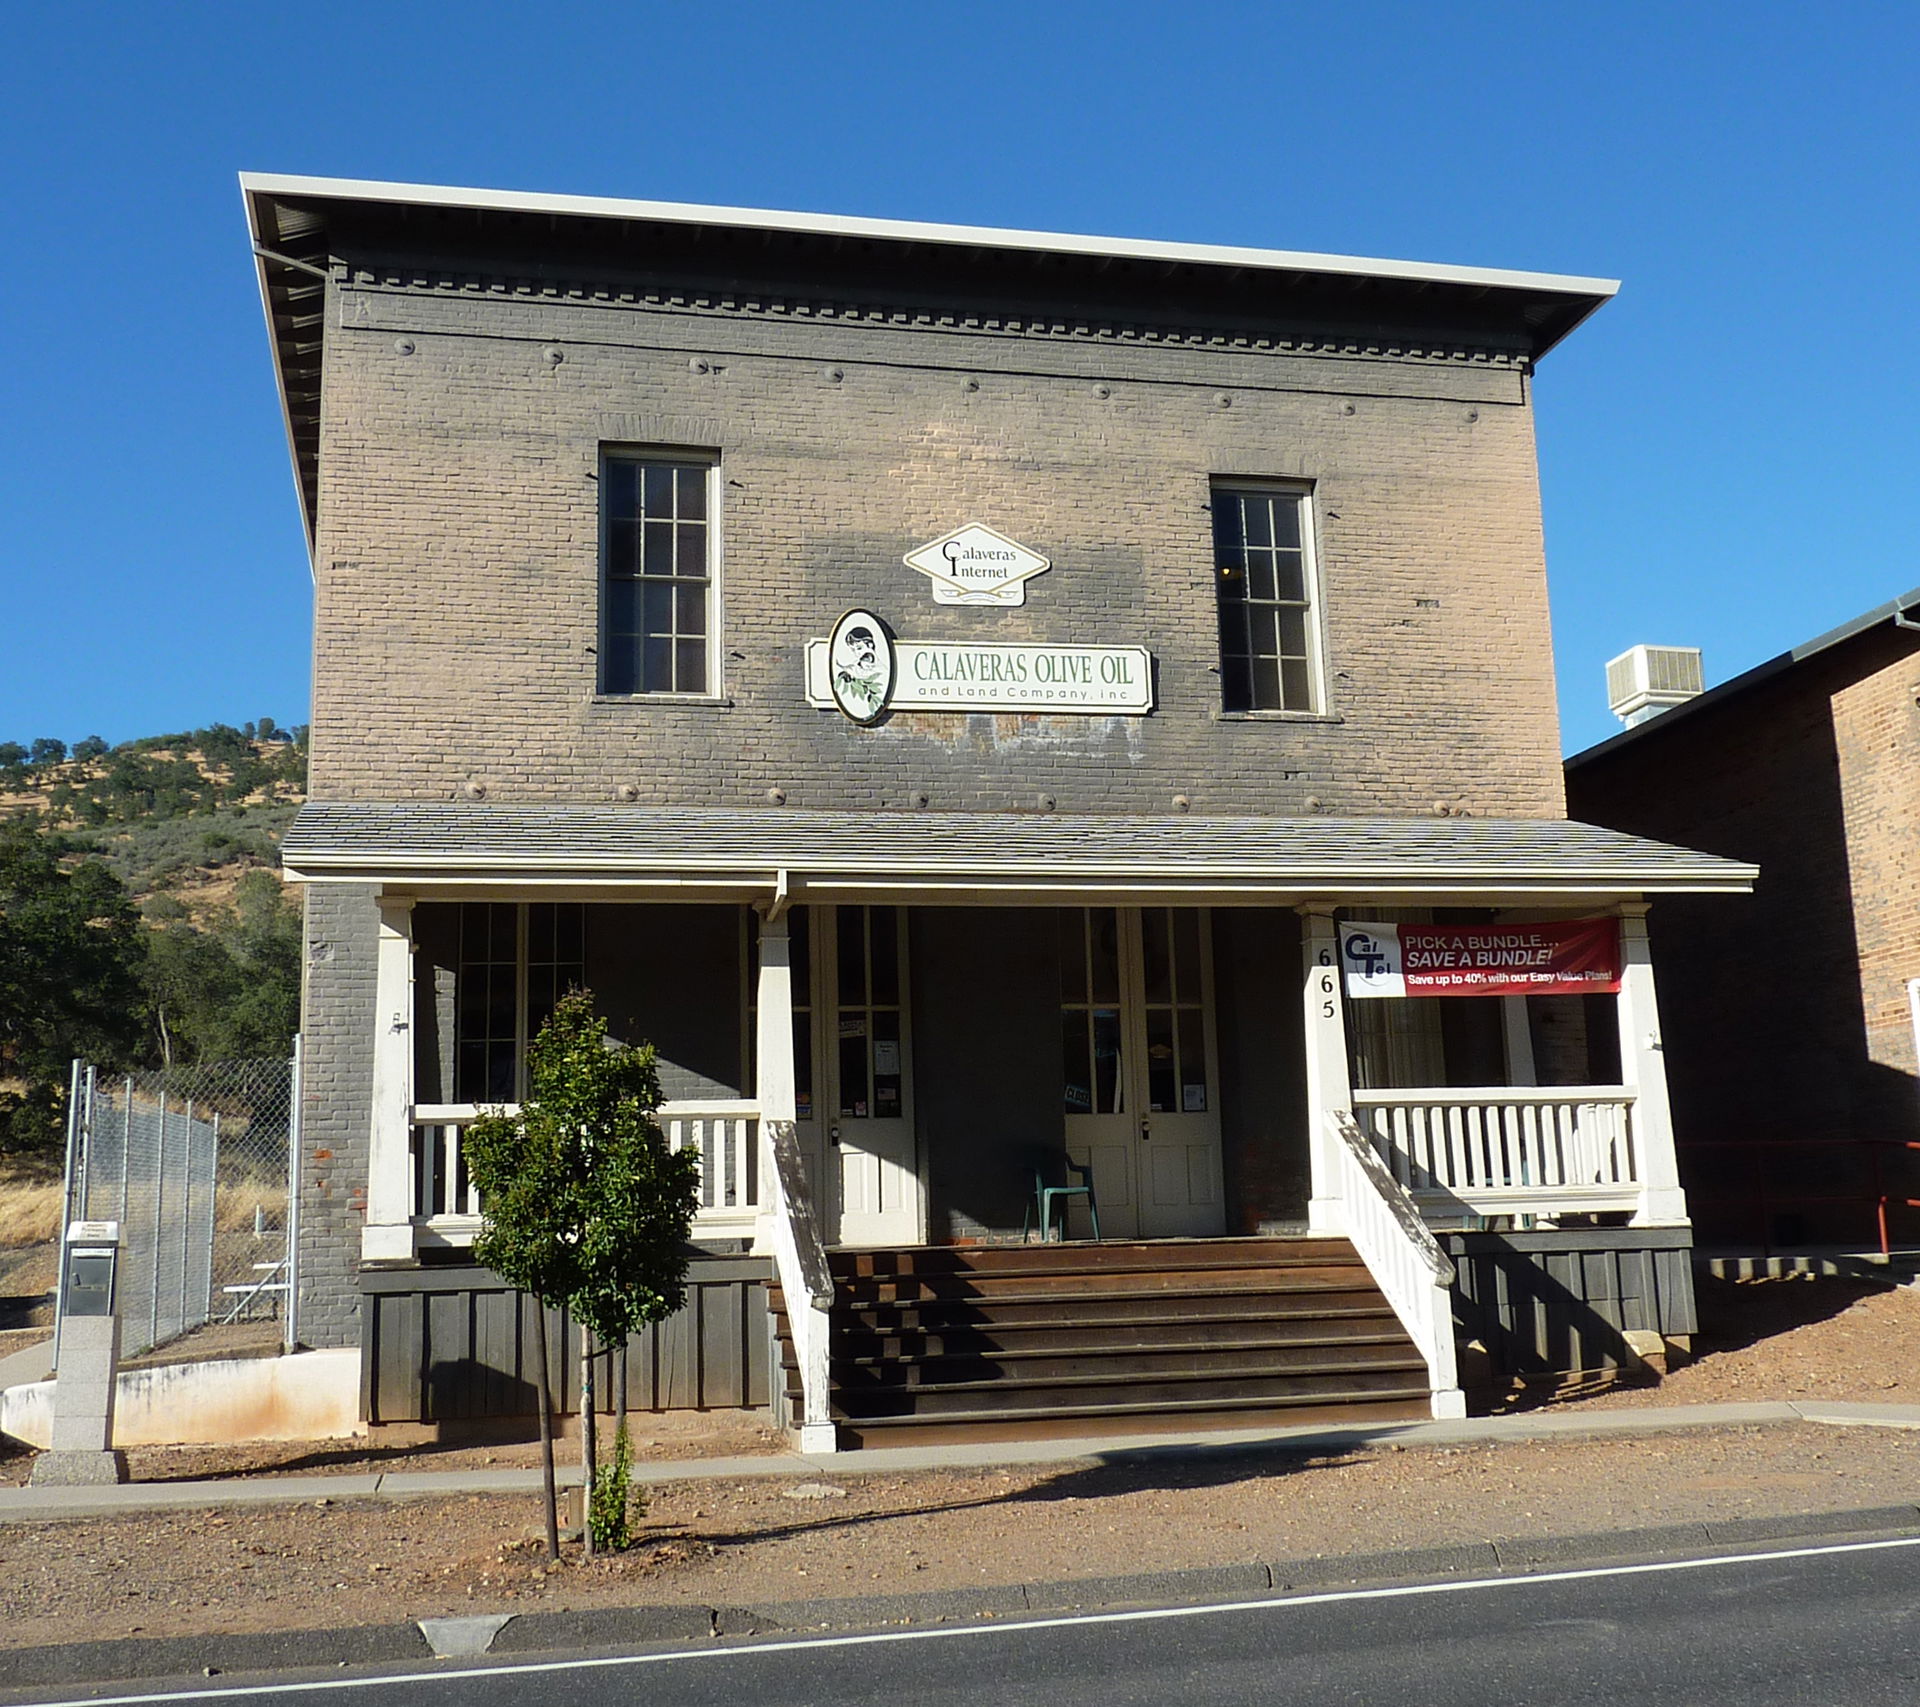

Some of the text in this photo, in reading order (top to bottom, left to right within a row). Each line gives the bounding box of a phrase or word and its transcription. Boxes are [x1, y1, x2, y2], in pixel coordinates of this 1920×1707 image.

[942, 541, 1017, 562] Calaveras
[950, 557, 1009, 579] Internet
[914, 652, 1134, 684] CALAVERAS OLIVE OIL
[918, 686, 949, 697] and
[958, 686, 998, 697] Land
[1345, 934, 1377, 960] Cal
[1405, 935, 1559, 949] PICK A BUNDLE...
[1357, 953, 1391, 979] Tel
[1406, 949, 1552, 967] SAVE A BUNDLE!
[1408, 970, 1612, 986] Save up to 40% with our Easy Value Plans!
